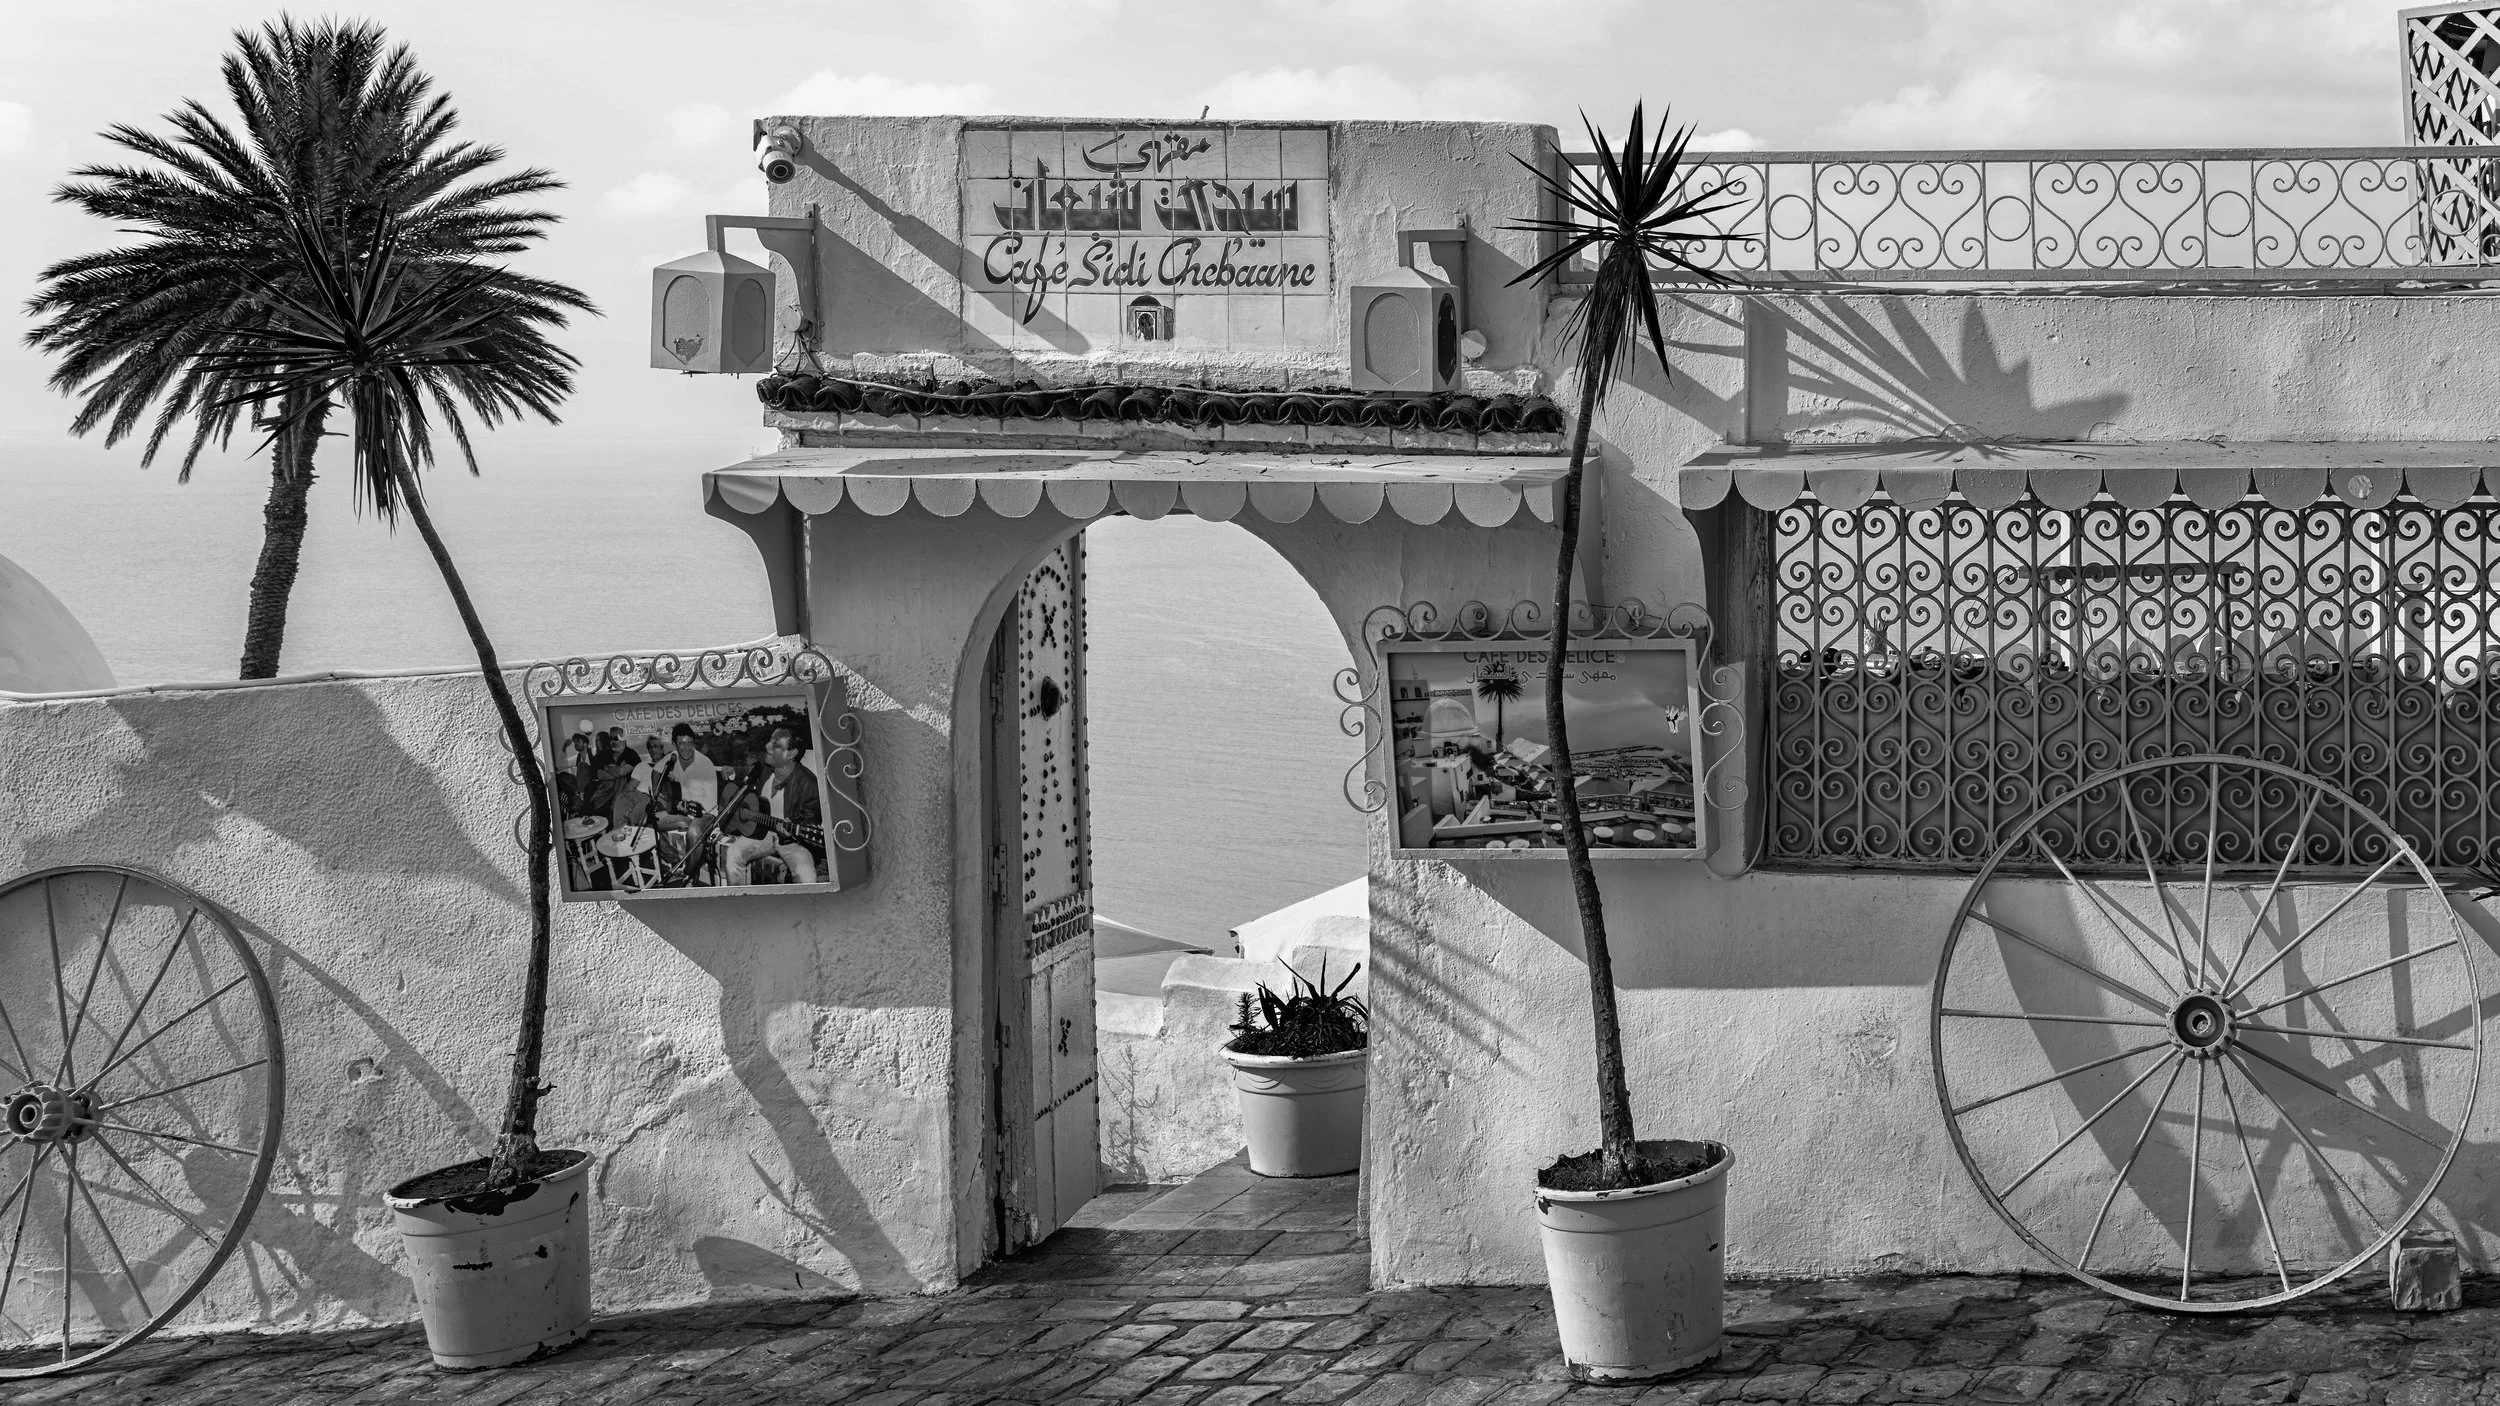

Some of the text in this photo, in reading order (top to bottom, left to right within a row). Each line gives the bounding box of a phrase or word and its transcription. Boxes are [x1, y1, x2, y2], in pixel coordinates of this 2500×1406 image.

[983, 230, 1068, 326] Café
[1067, 232, 1152, 290] Sidi
[1463, 651, 1626, 664] CAFE DES ELICES
[614, 702, 744, 721] CAFE DES DELICES
